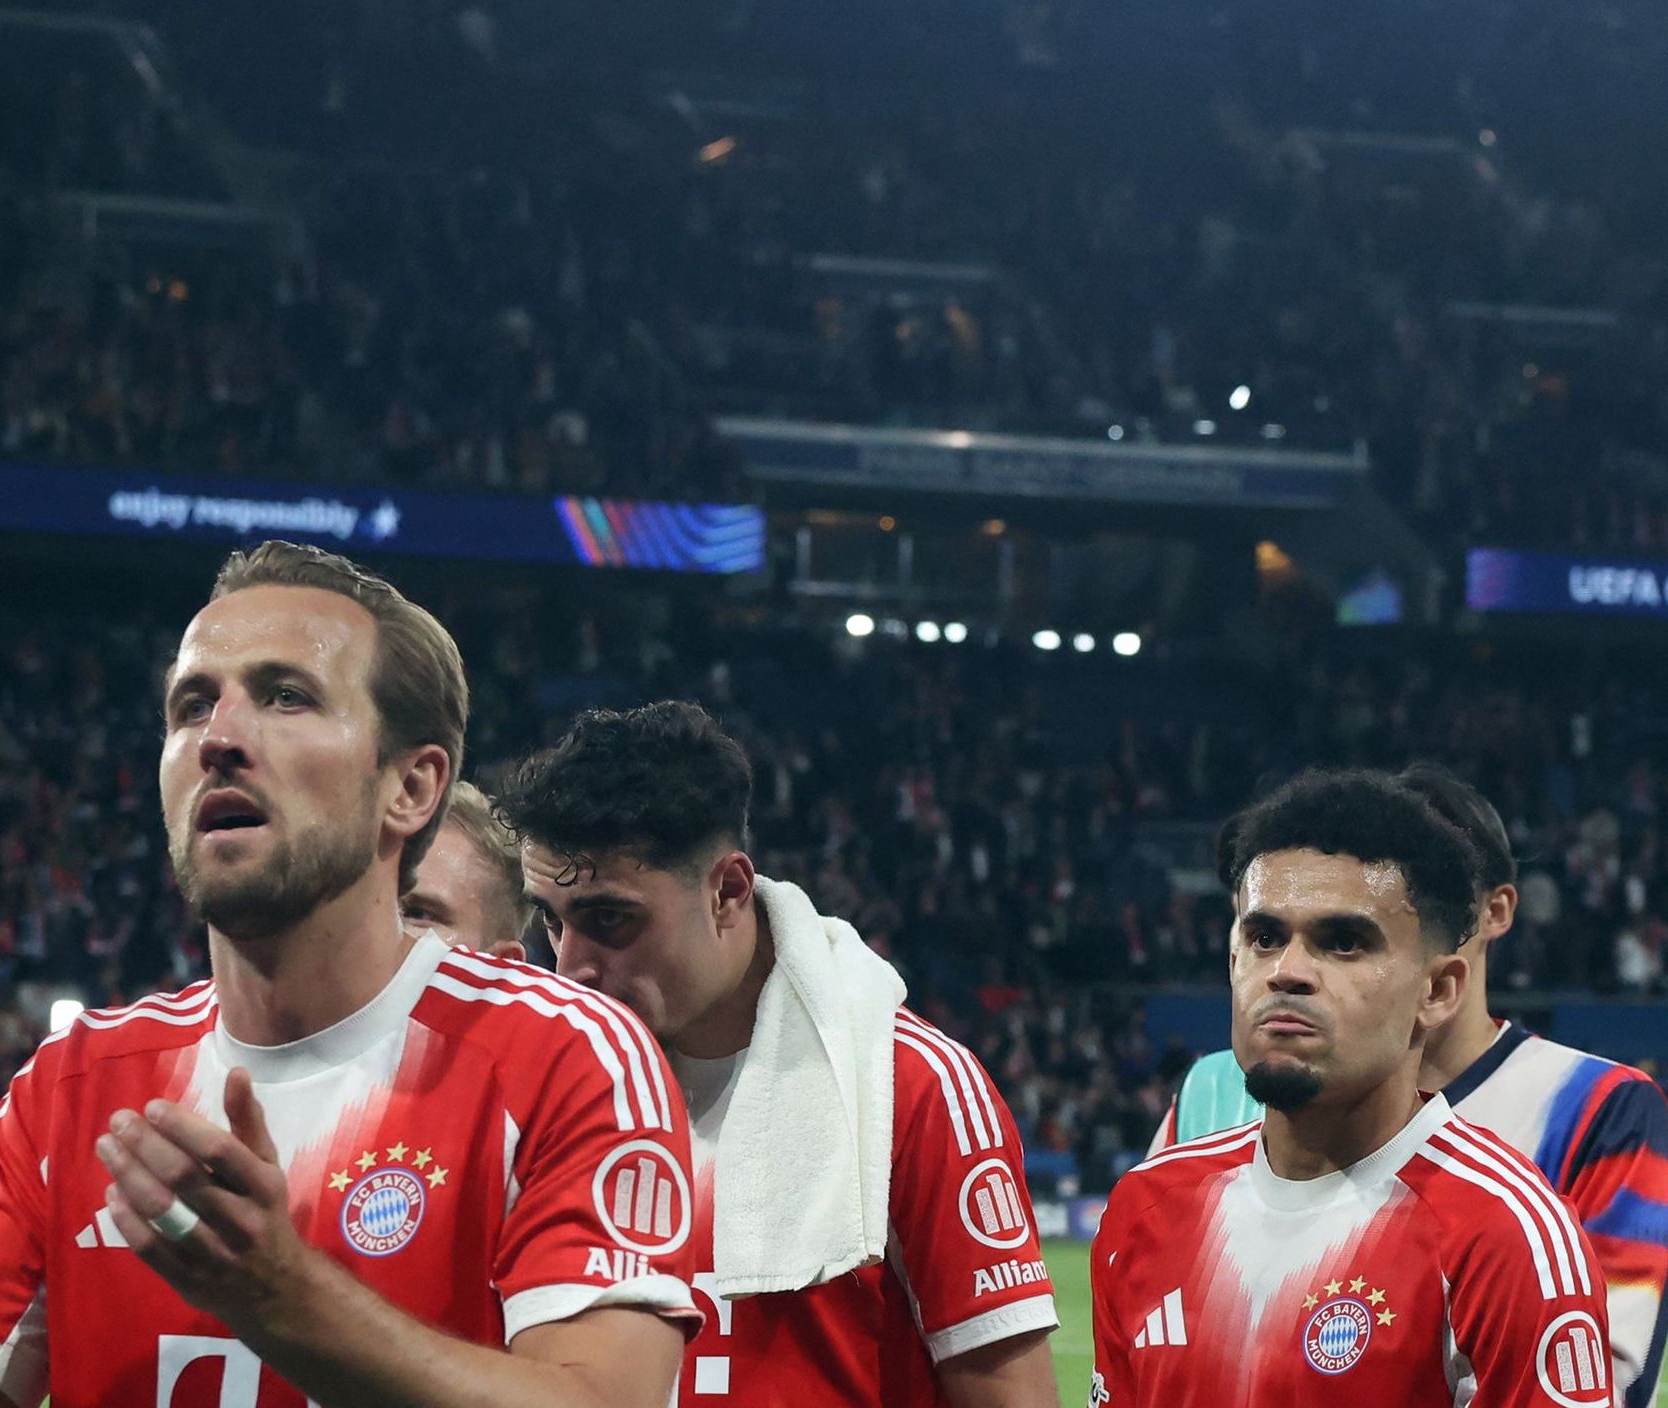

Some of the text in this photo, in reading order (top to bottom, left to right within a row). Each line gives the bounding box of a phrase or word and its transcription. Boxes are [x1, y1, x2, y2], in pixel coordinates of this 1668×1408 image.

[109, 487, 358, 539] enjoy responsibly
[1569, 566, 1660, 605] UEFA
[351, 1174, 421, 1208] FC BAYERN
[583, 1246, 660, 1281] Alli
[1314, 1303, 1368, 1336] FC BAYERN
